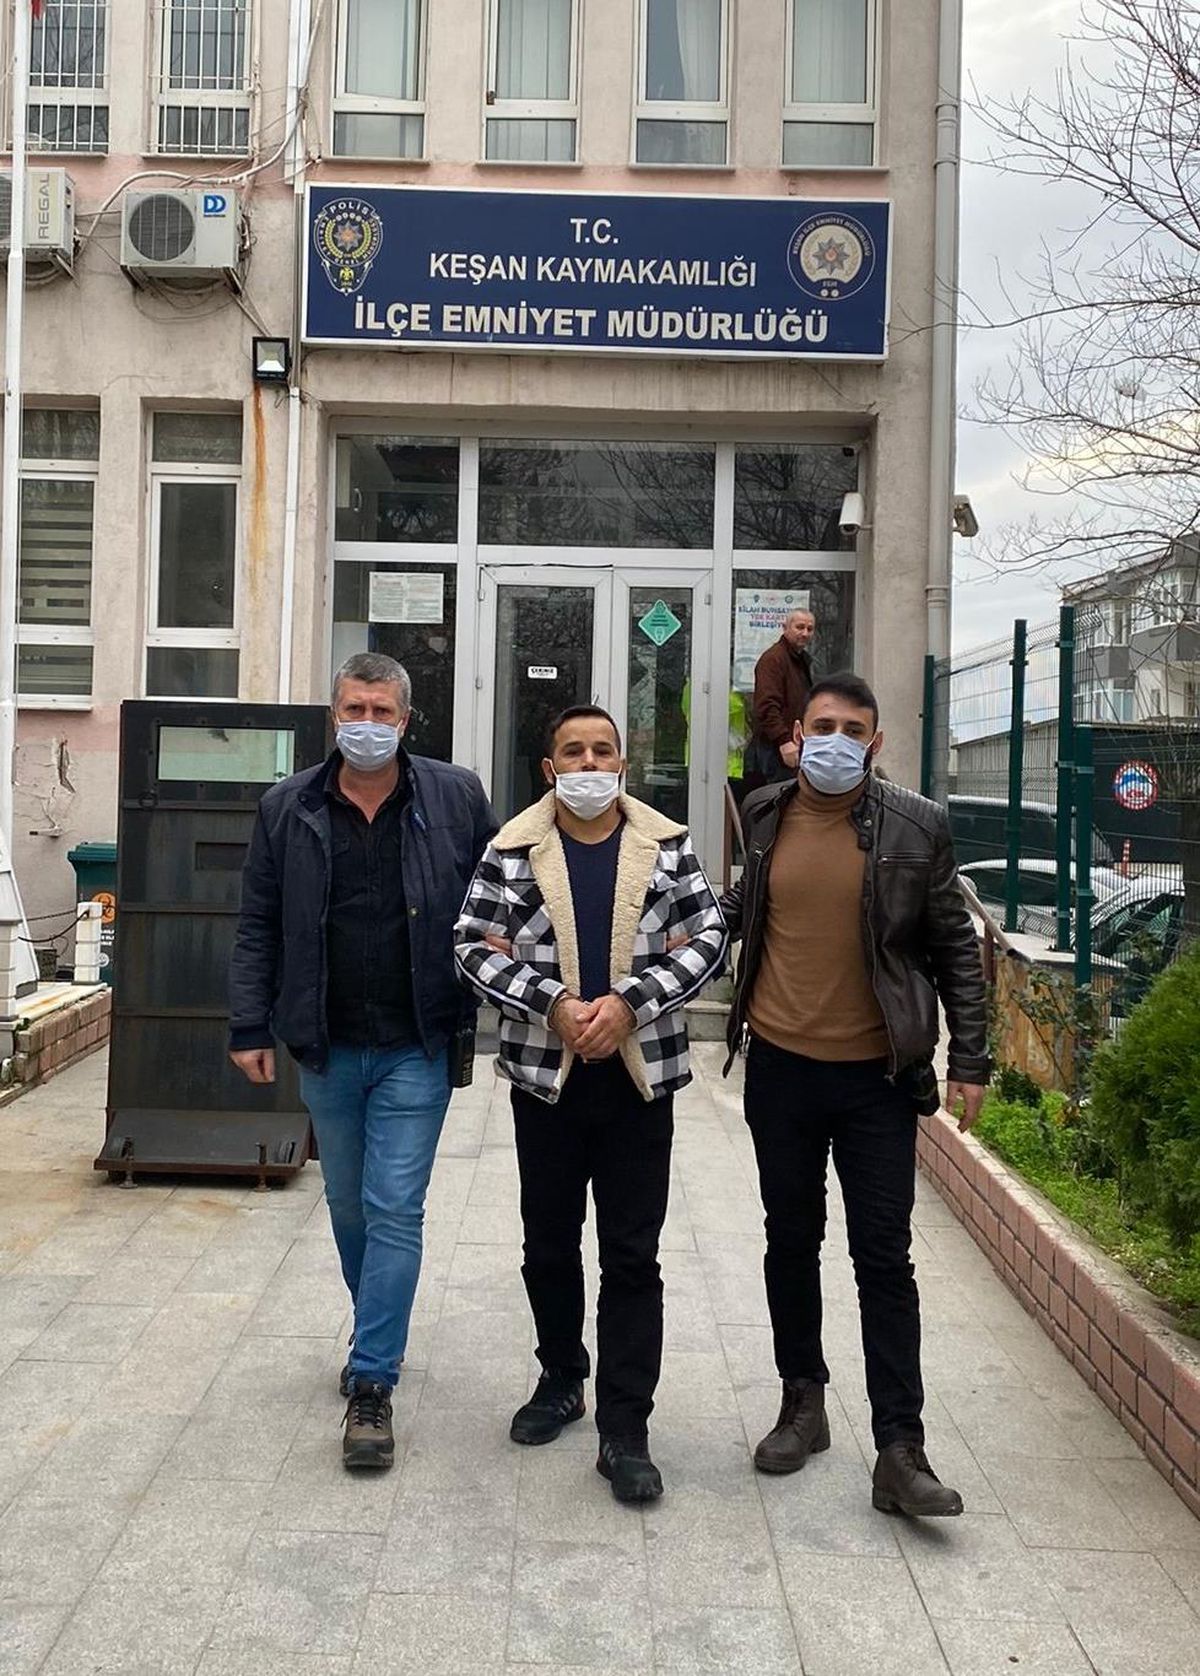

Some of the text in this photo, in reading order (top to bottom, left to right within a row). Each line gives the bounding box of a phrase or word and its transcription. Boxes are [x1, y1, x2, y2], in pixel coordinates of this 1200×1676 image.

[38, 172, 50, 239] REGAL
[569, 218, 619, 244] T.C.
[429, 252, 756, 287] KEŞAN KAYMAKAMLIĞI
[354, 295, 828, 342] İLÇE EMNİYET MÜDÜRLÜĞÜ
